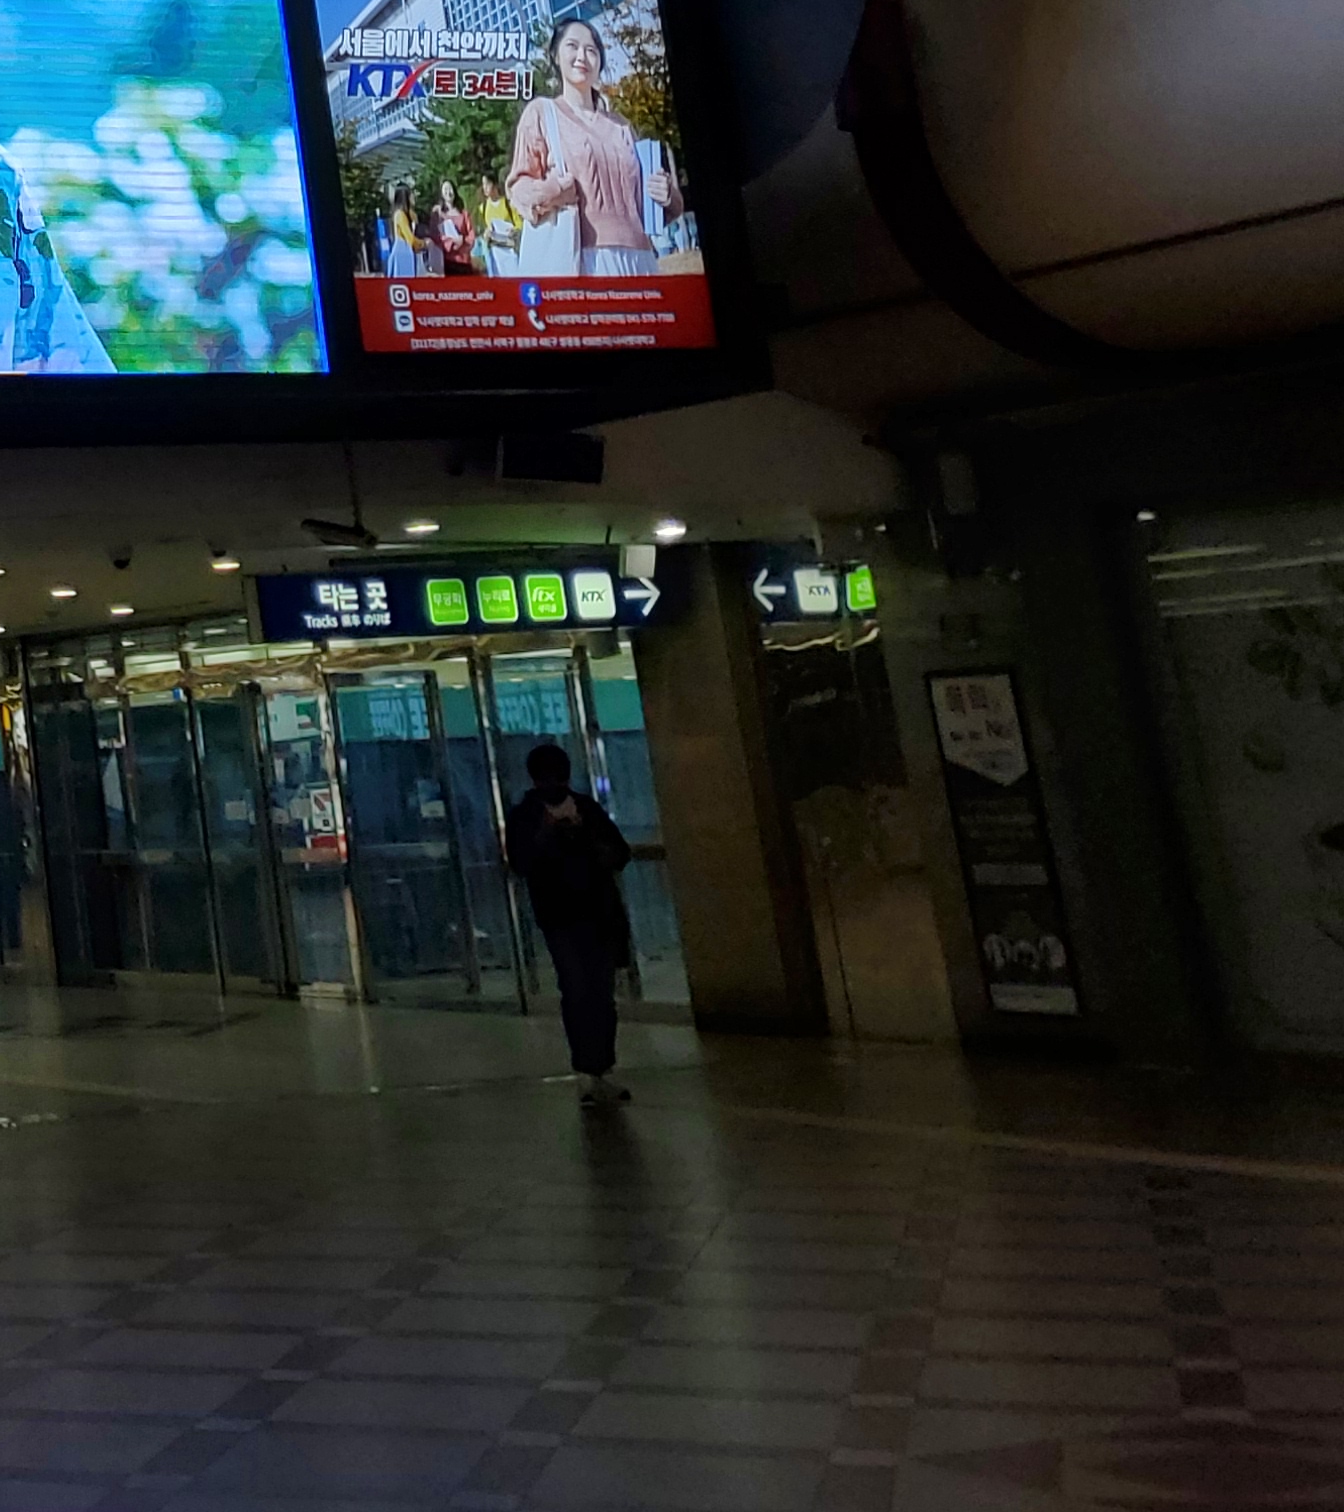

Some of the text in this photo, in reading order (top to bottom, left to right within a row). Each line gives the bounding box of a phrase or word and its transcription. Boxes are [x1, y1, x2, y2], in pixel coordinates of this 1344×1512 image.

[339, 29, 527, 59] 서울에서 천안까지
[462, 71, 518, 99] 34분
[318, 581, 388, 611] 타는 곳
[581, 589, 606, 601] KTX
[304, 614, 338, 628] Tracks
